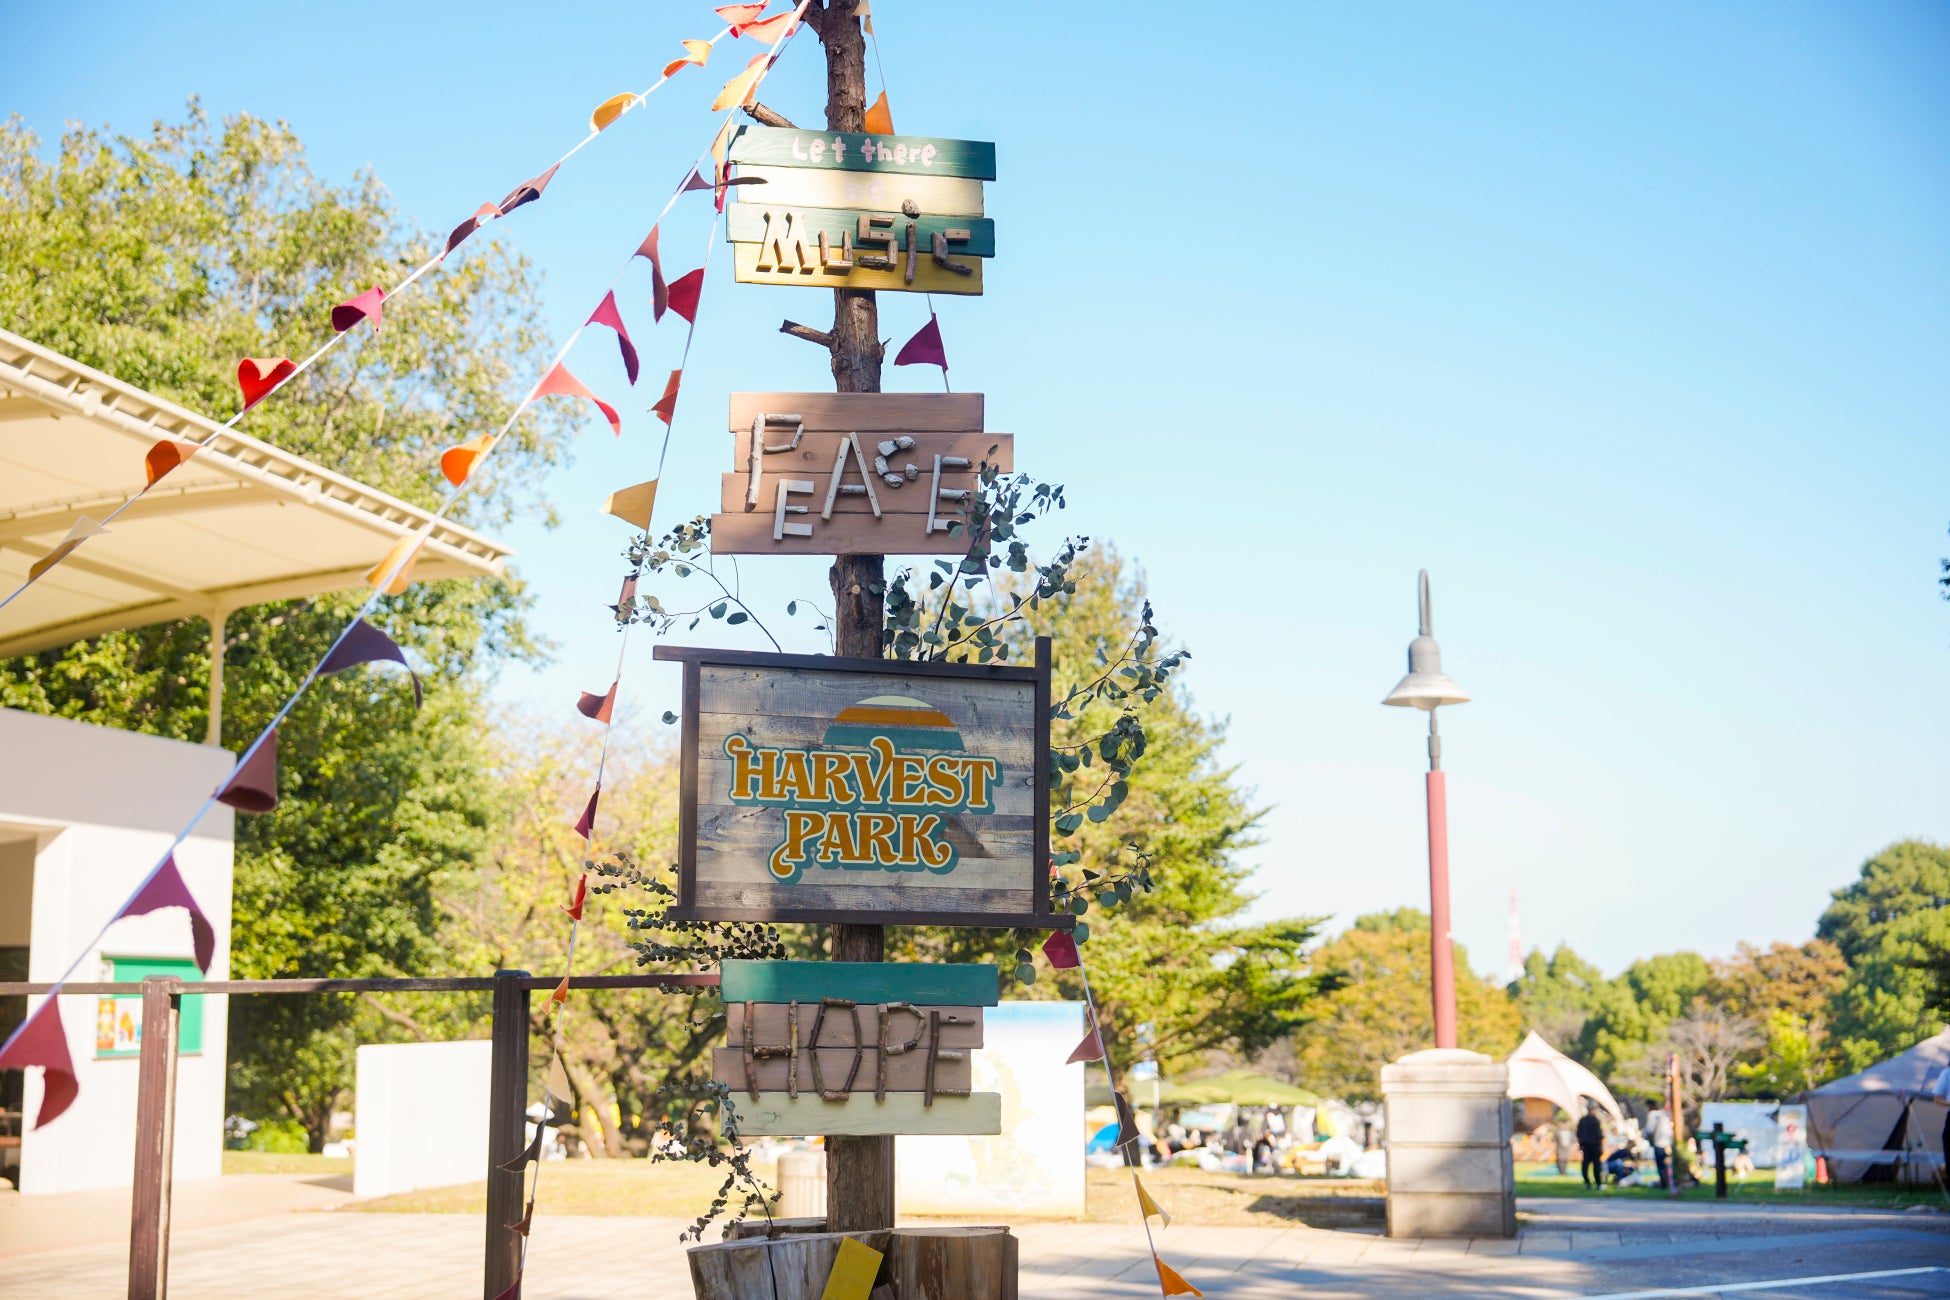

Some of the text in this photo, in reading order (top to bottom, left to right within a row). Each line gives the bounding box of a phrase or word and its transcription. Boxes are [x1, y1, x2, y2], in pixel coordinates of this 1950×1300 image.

[792, 136, 937, 167] Let there
[844, 178, 886, 200] be
[747, 413, 974, 540] PEACE
[724, 735, 1000, 808] HARVEST
[769, 809, 957, 883] PARK
[743, 997, 977, 1107] HOPE
